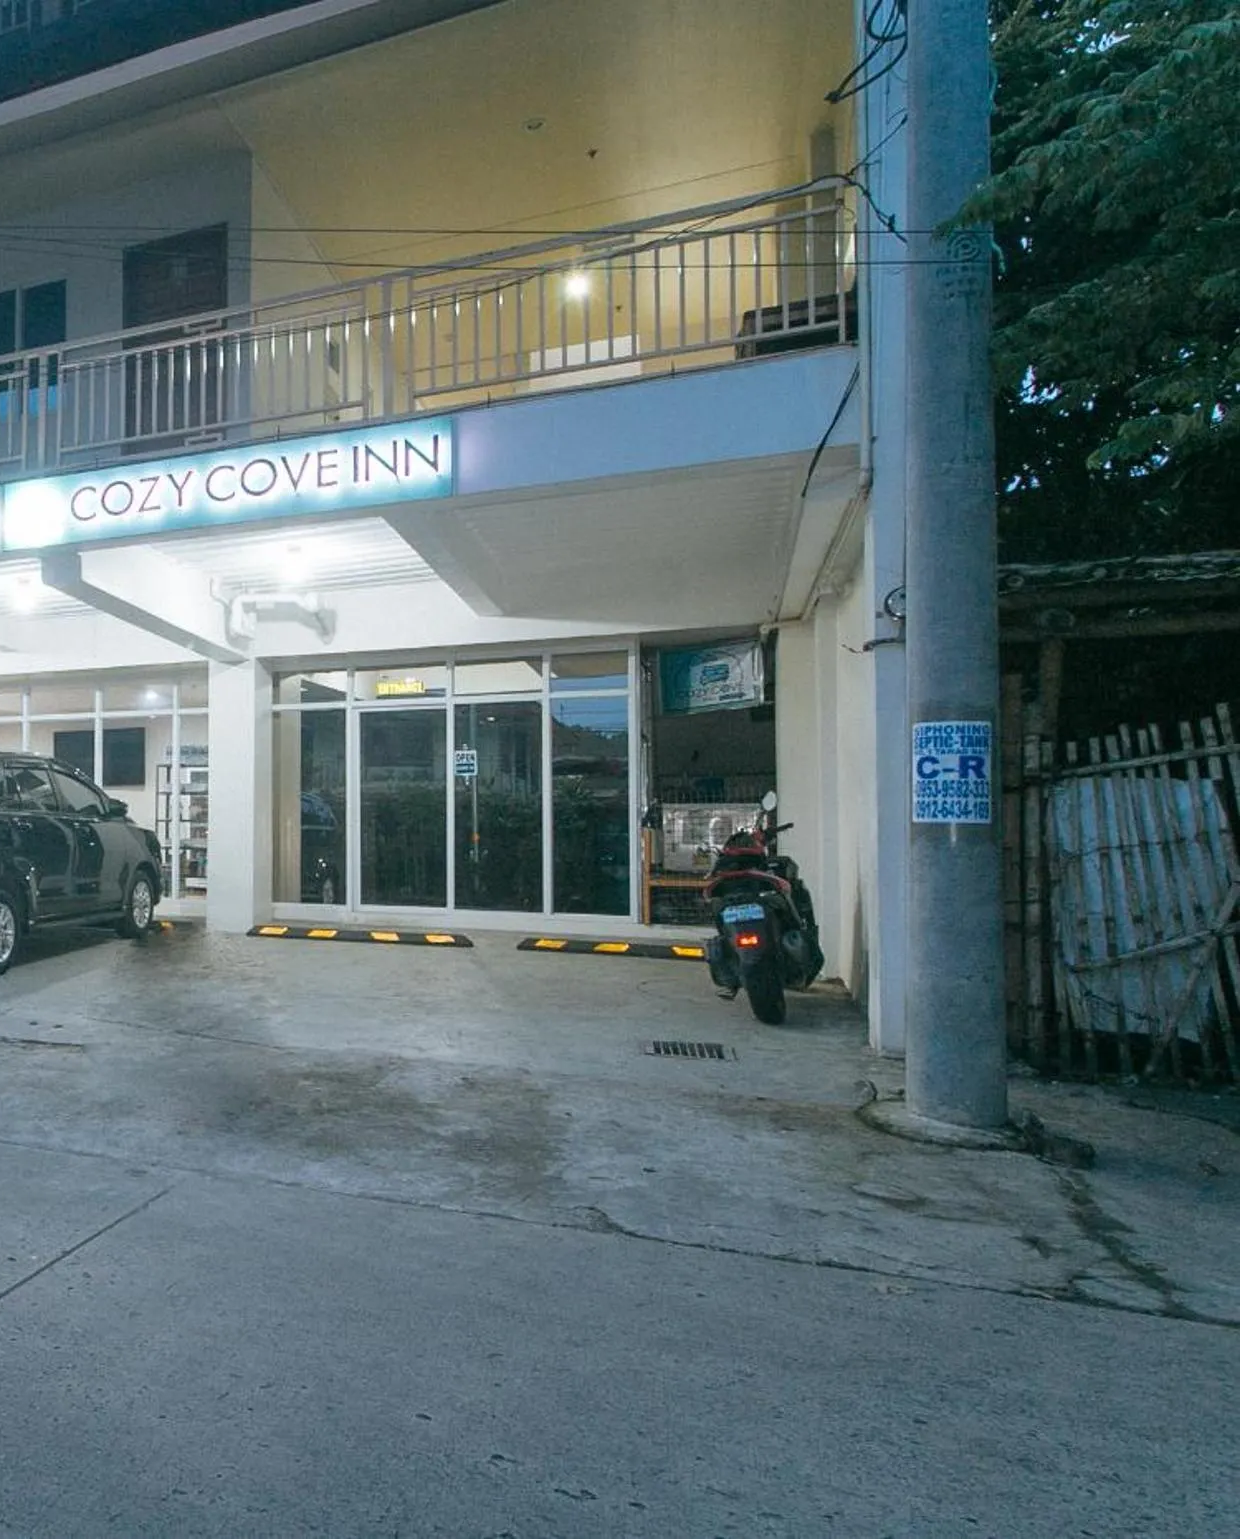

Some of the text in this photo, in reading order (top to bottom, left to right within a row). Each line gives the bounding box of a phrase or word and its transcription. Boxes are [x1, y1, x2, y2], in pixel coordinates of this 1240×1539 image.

[70, 434, 440, 521] COZY COVE INN
[917, 755, 986, 779] C-R
